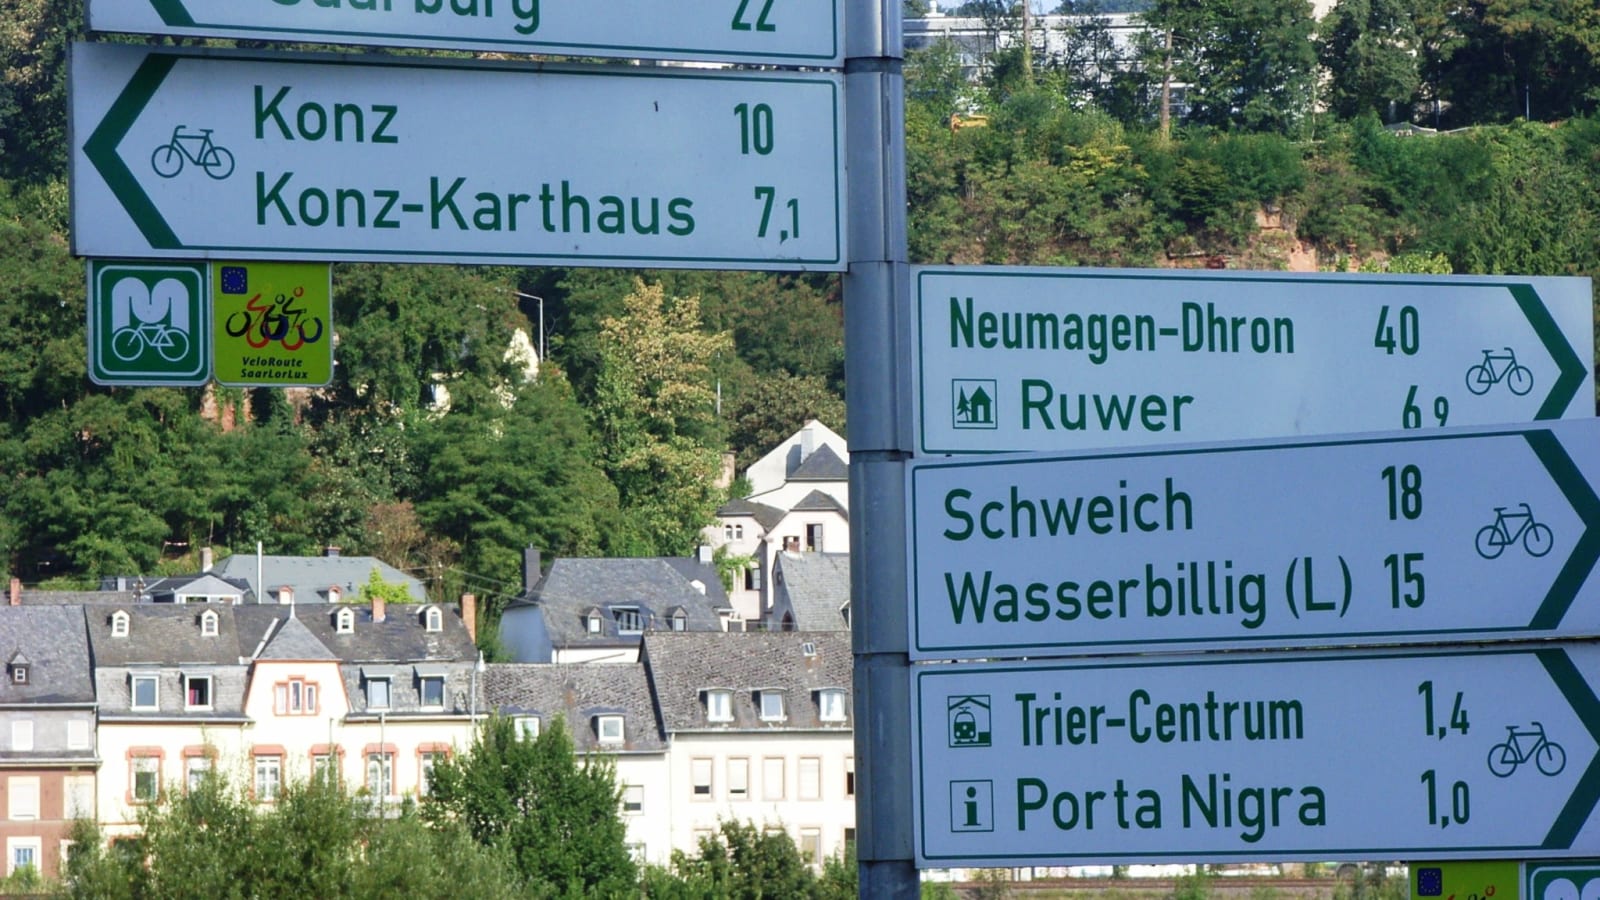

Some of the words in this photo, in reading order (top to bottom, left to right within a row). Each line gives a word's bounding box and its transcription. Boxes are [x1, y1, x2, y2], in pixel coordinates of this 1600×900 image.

[254, 85, 399, 144] Konz
[733, 103, 774, 156] 10
[256, 172, 696, 237] Konz-Karthaus
[755, 187, 800, 243] 7,1
[242, 357, 303, 368] VeloRoute
[950, 297, 1294, 365] Neumagen-Dhron
[1375, 306, 1420, 356] 40
[241, 369, 308, 380] SaarLorLux
[1022, 379, 1195, 432] Ruwer
[944, 477, 1193, 542] Schweich
[1382, 464, 1423, 521] 18
[944, 560, 1267, 630] Wasserbillig
[1286, 555, 1353, 620] (L)
[1384, 553, 1426, 609] 15
[1015, 689, 1304, 747] Trier-Centrum
[1418, 680, 1471, 741] 1,4
[1017, 778, 1162, 832] Porta
[1182, 773, 1327, 843] Nigra
[1421, 769, 1471, 830] 1,0
